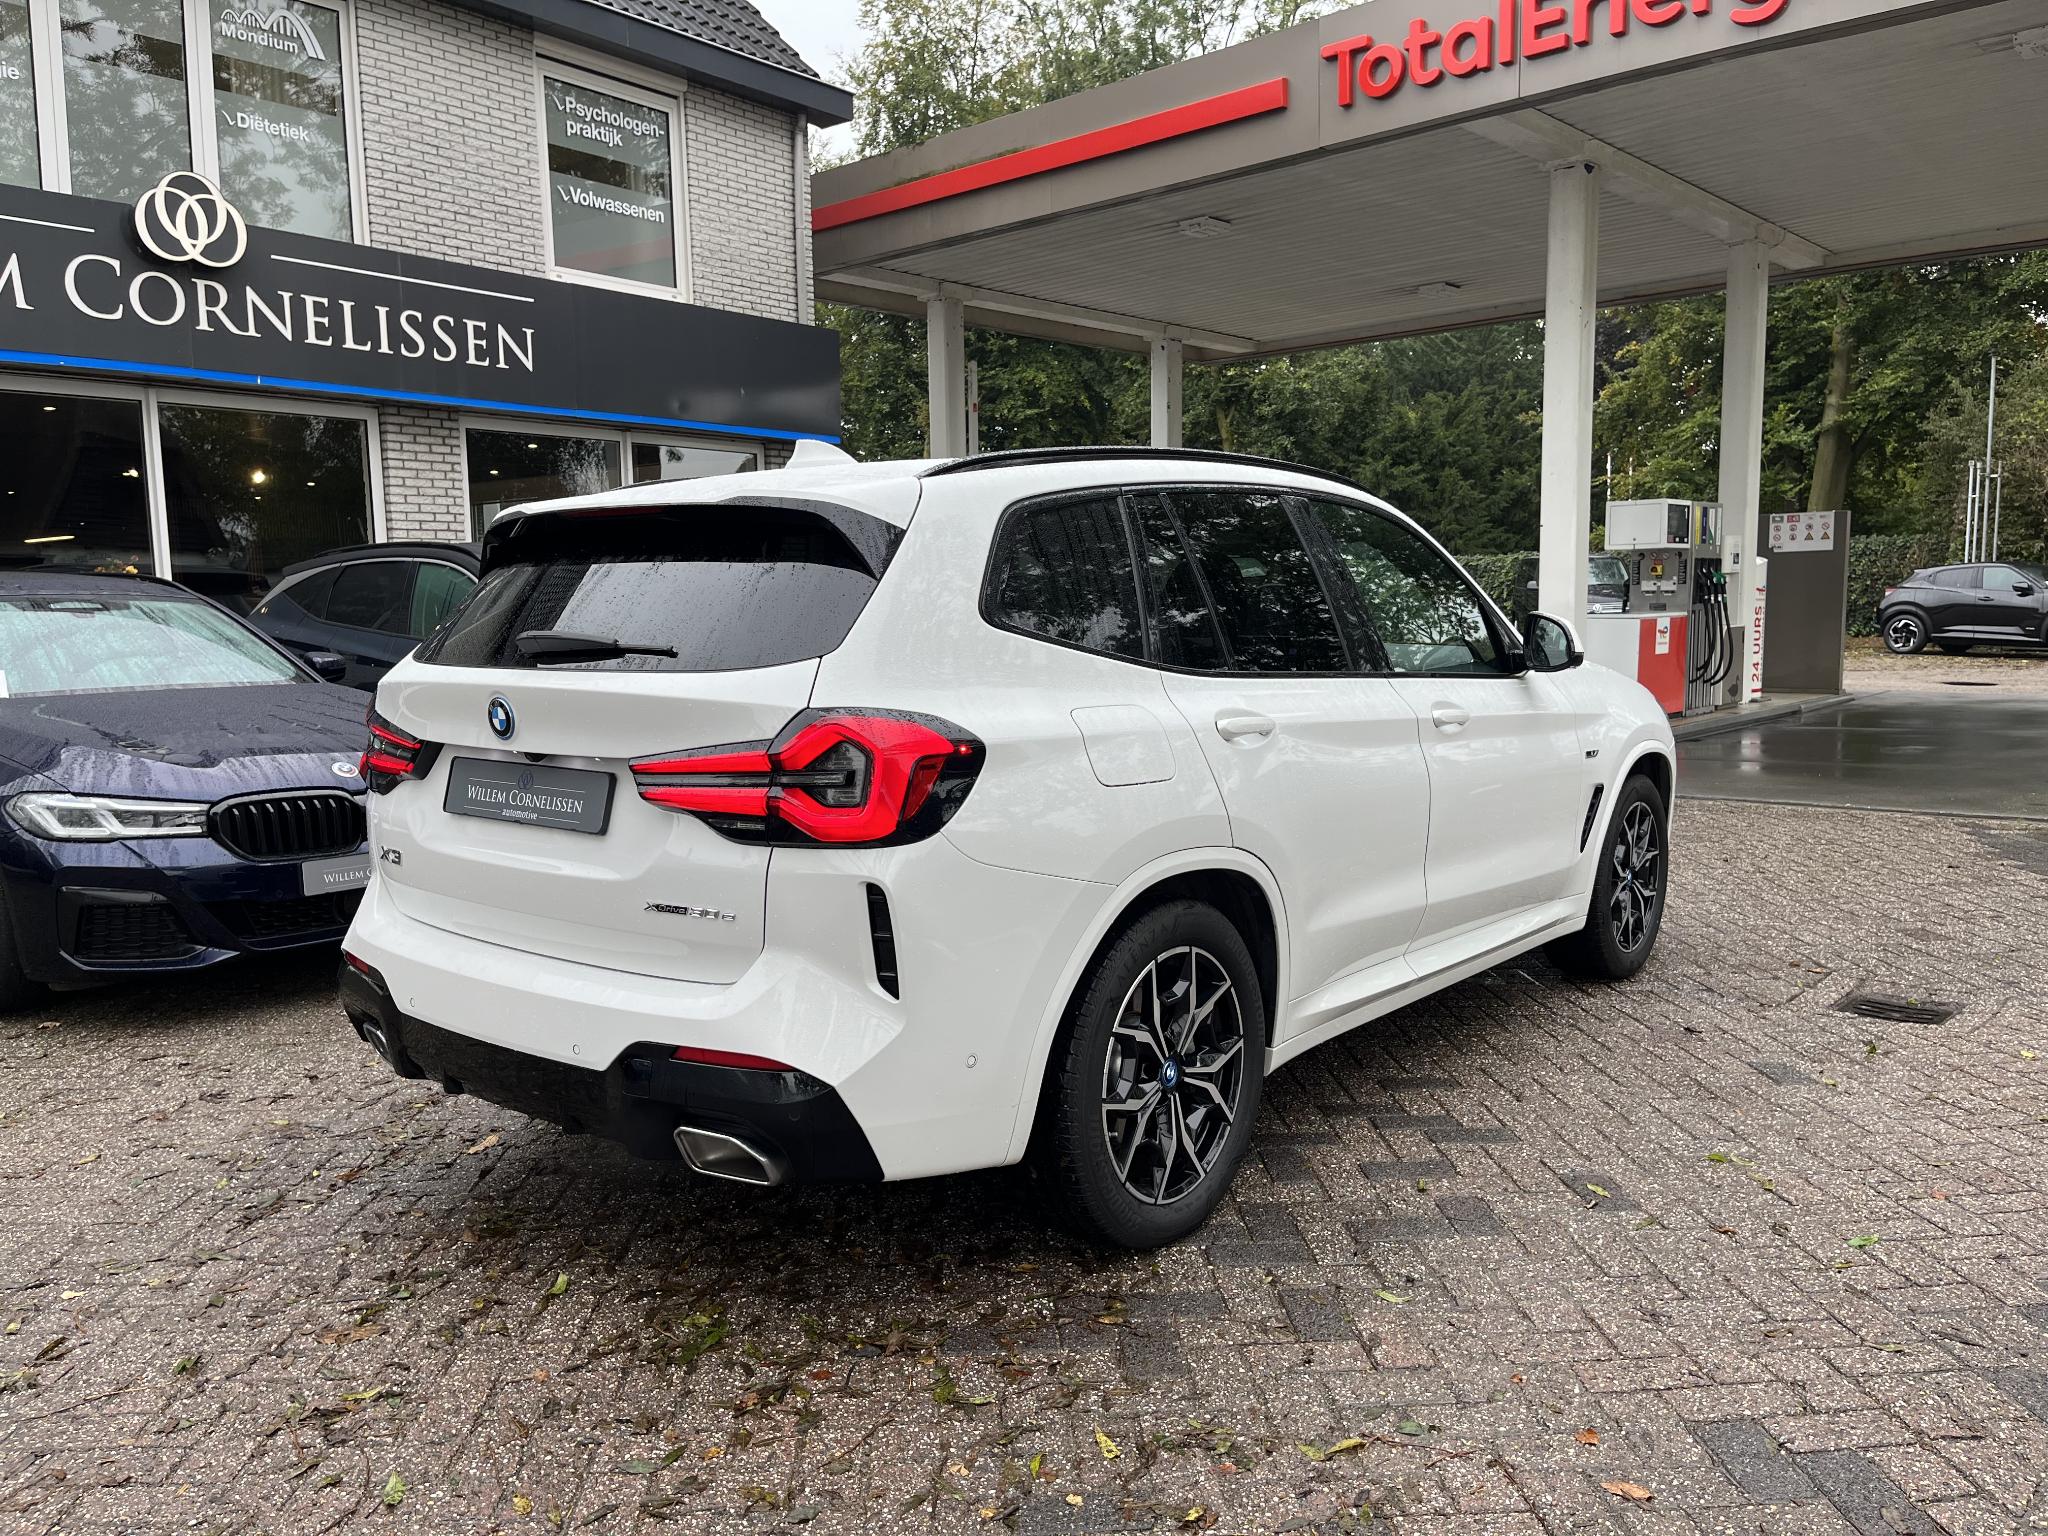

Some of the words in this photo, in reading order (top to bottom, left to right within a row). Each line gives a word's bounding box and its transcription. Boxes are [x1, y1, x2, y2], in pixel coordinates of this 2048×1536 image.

[221, 22, 298, 54] Mondium
[0, 61, 20, 80] ie
[236, 112, 310, 142] Diëtetiek
[565, 96, 665, 138] Psychologen-
[566, 120, 623, 148] praktijk
[569, 186, 665, 223] Volwassenen
[64, 254, 535, 373] CORNELISSEN
[1753, 606, 1763, 655] UURS
[1751, 661, 1760, 683] 24
[468, 784, 506, 804] WILLEM
[509, 789, 583, 814] CORNELISSEN
[502, 807, 538, 820] automotive
[380, 845, 402, 866] X3
[323, 870, 364, 884] WILLEM
